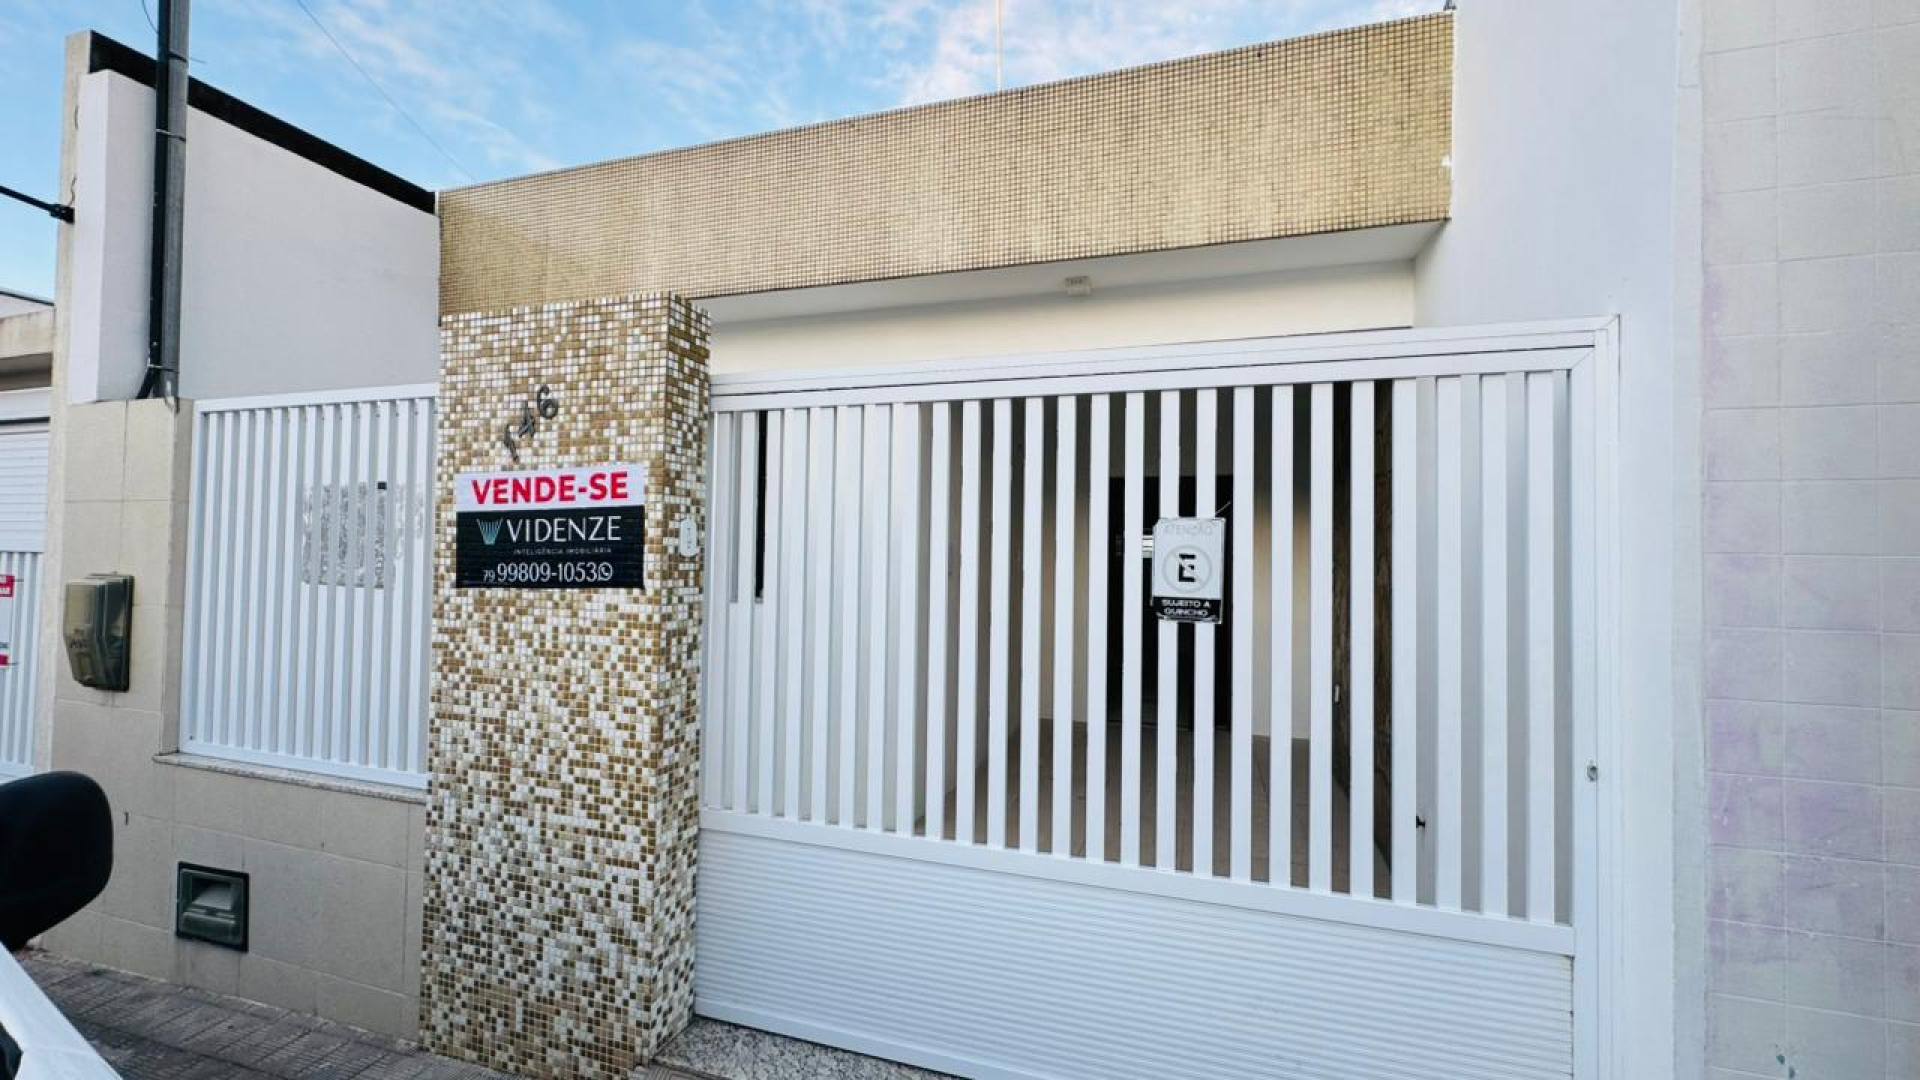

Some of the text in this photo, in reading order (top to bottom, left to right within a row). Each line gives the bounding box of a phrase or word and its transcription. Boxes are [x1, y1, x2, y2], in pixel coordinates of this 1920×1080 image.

[472, 471, 629, 505] VENDE-SE
[506, 515, 622, 543] VIDENZE
[497, 561, 598, 583] 99809-1053
